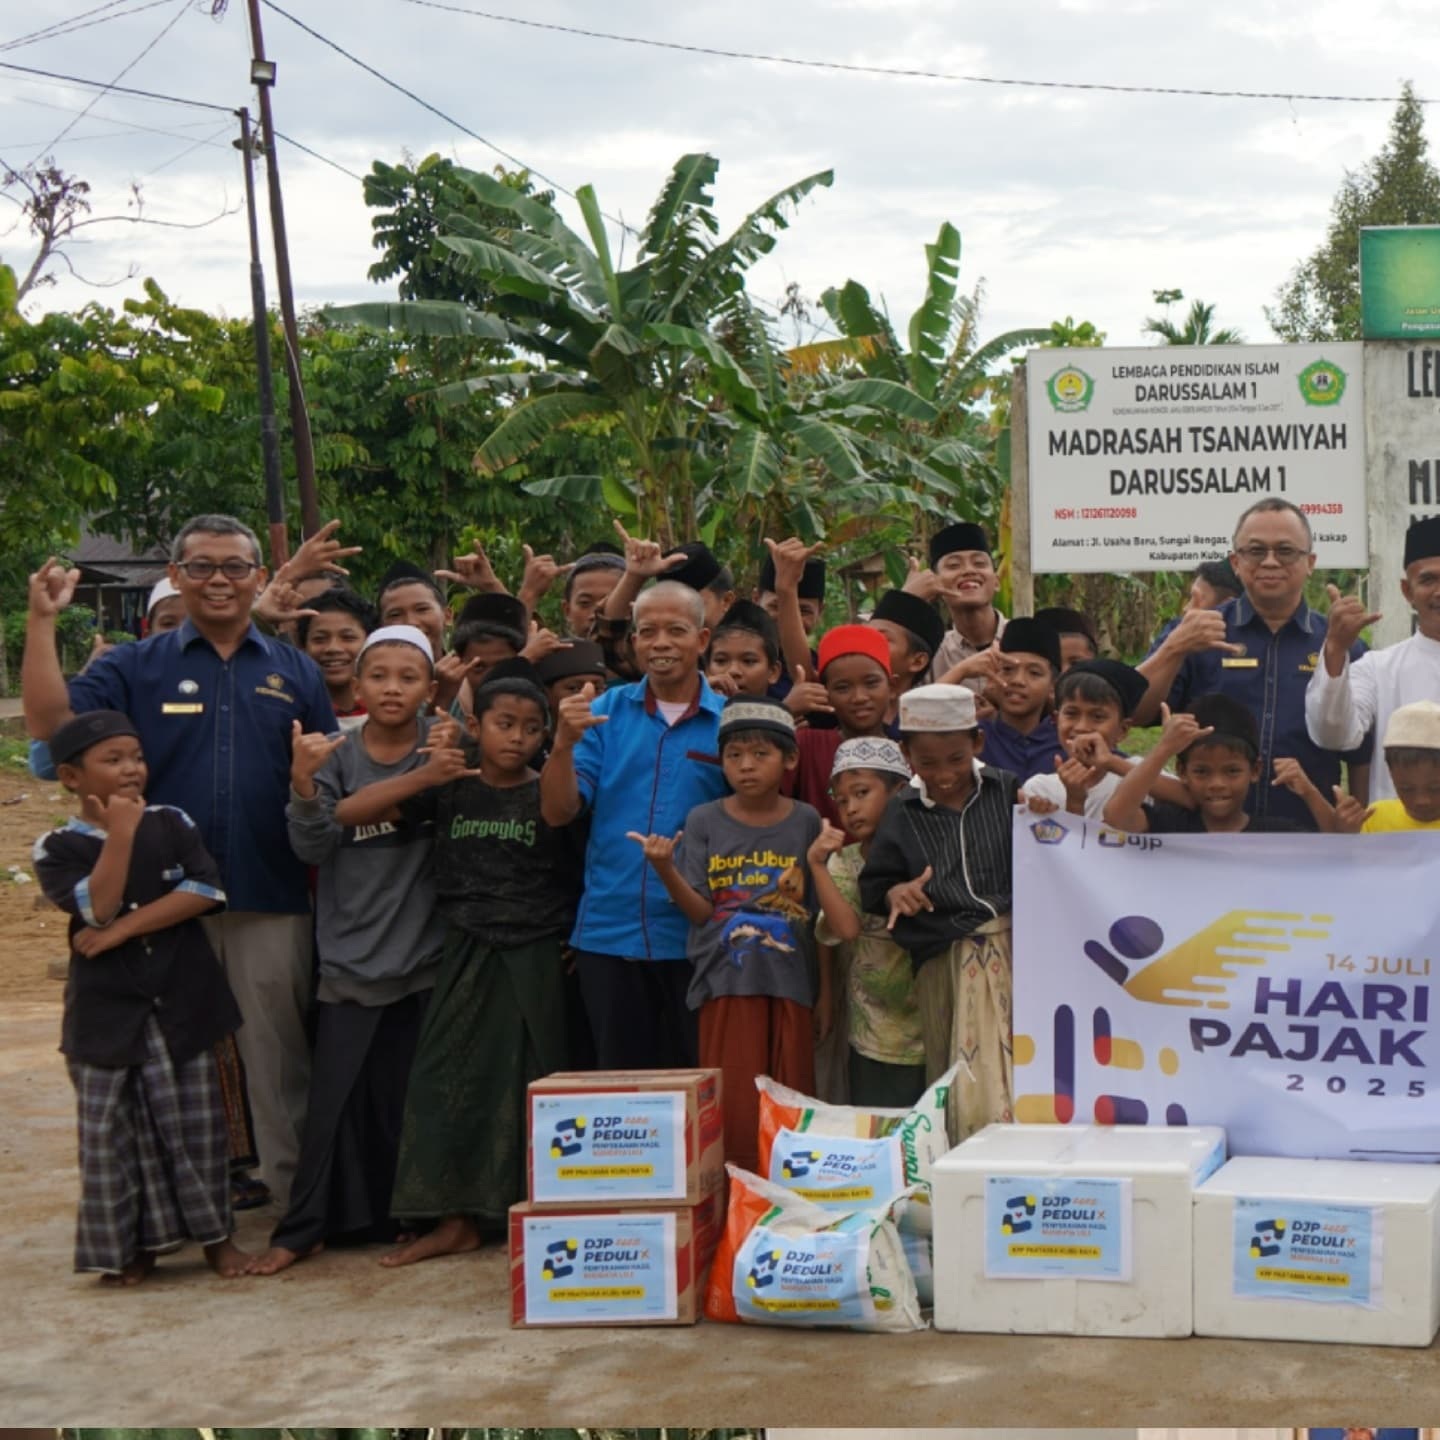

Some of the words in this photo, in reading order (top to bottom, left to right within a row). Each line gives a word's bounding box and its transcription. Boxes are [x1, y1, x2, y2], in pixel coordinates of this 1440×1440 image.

[1112, 365, 1167, 379] LEMBAGA
[1170, 363, 1242, 377] PENDIDIKAN
[1245, 362, 1279, 376] ISLAM
[1135, 383, 1247, 402] DARUSSALAM
[1251, 382, 1257, 399] 1
[1048, 427, 1182, 456] MADRASAH
[1189, 424, 1347, 453] TSANAWIYAH
[1110, 468, 1271, 496] DARUSSALAM
[1277, 466, 1287, 492] 1
[1052, 537, 1084, 547] Alamat
[1160, 535, 1190, 546] Sungai
[1325, 953, 1356, 972] 14
[1364, 955, 1431, 975] JULI
[1254, 976, 1429, 1023] HARI
[1189, 1017, 1428, 1068] PAJAK
[592, 1117, 622, 1128] DJP
[592, 1130, 647, 1141] PEDULI
[1042, 1196, 1071, 1207] DJP
[1041, 1210, 1096, 1220] PEDULI
[1291, 1221, 1320, 1232] DJP
[584, 1238, 614, 1249] DJP
[1291, 1234, 1345, 1247] PEDULI
[584, 1250, 638, 1262] PEDULI
[785, 1251, 815, 1263] DJP
